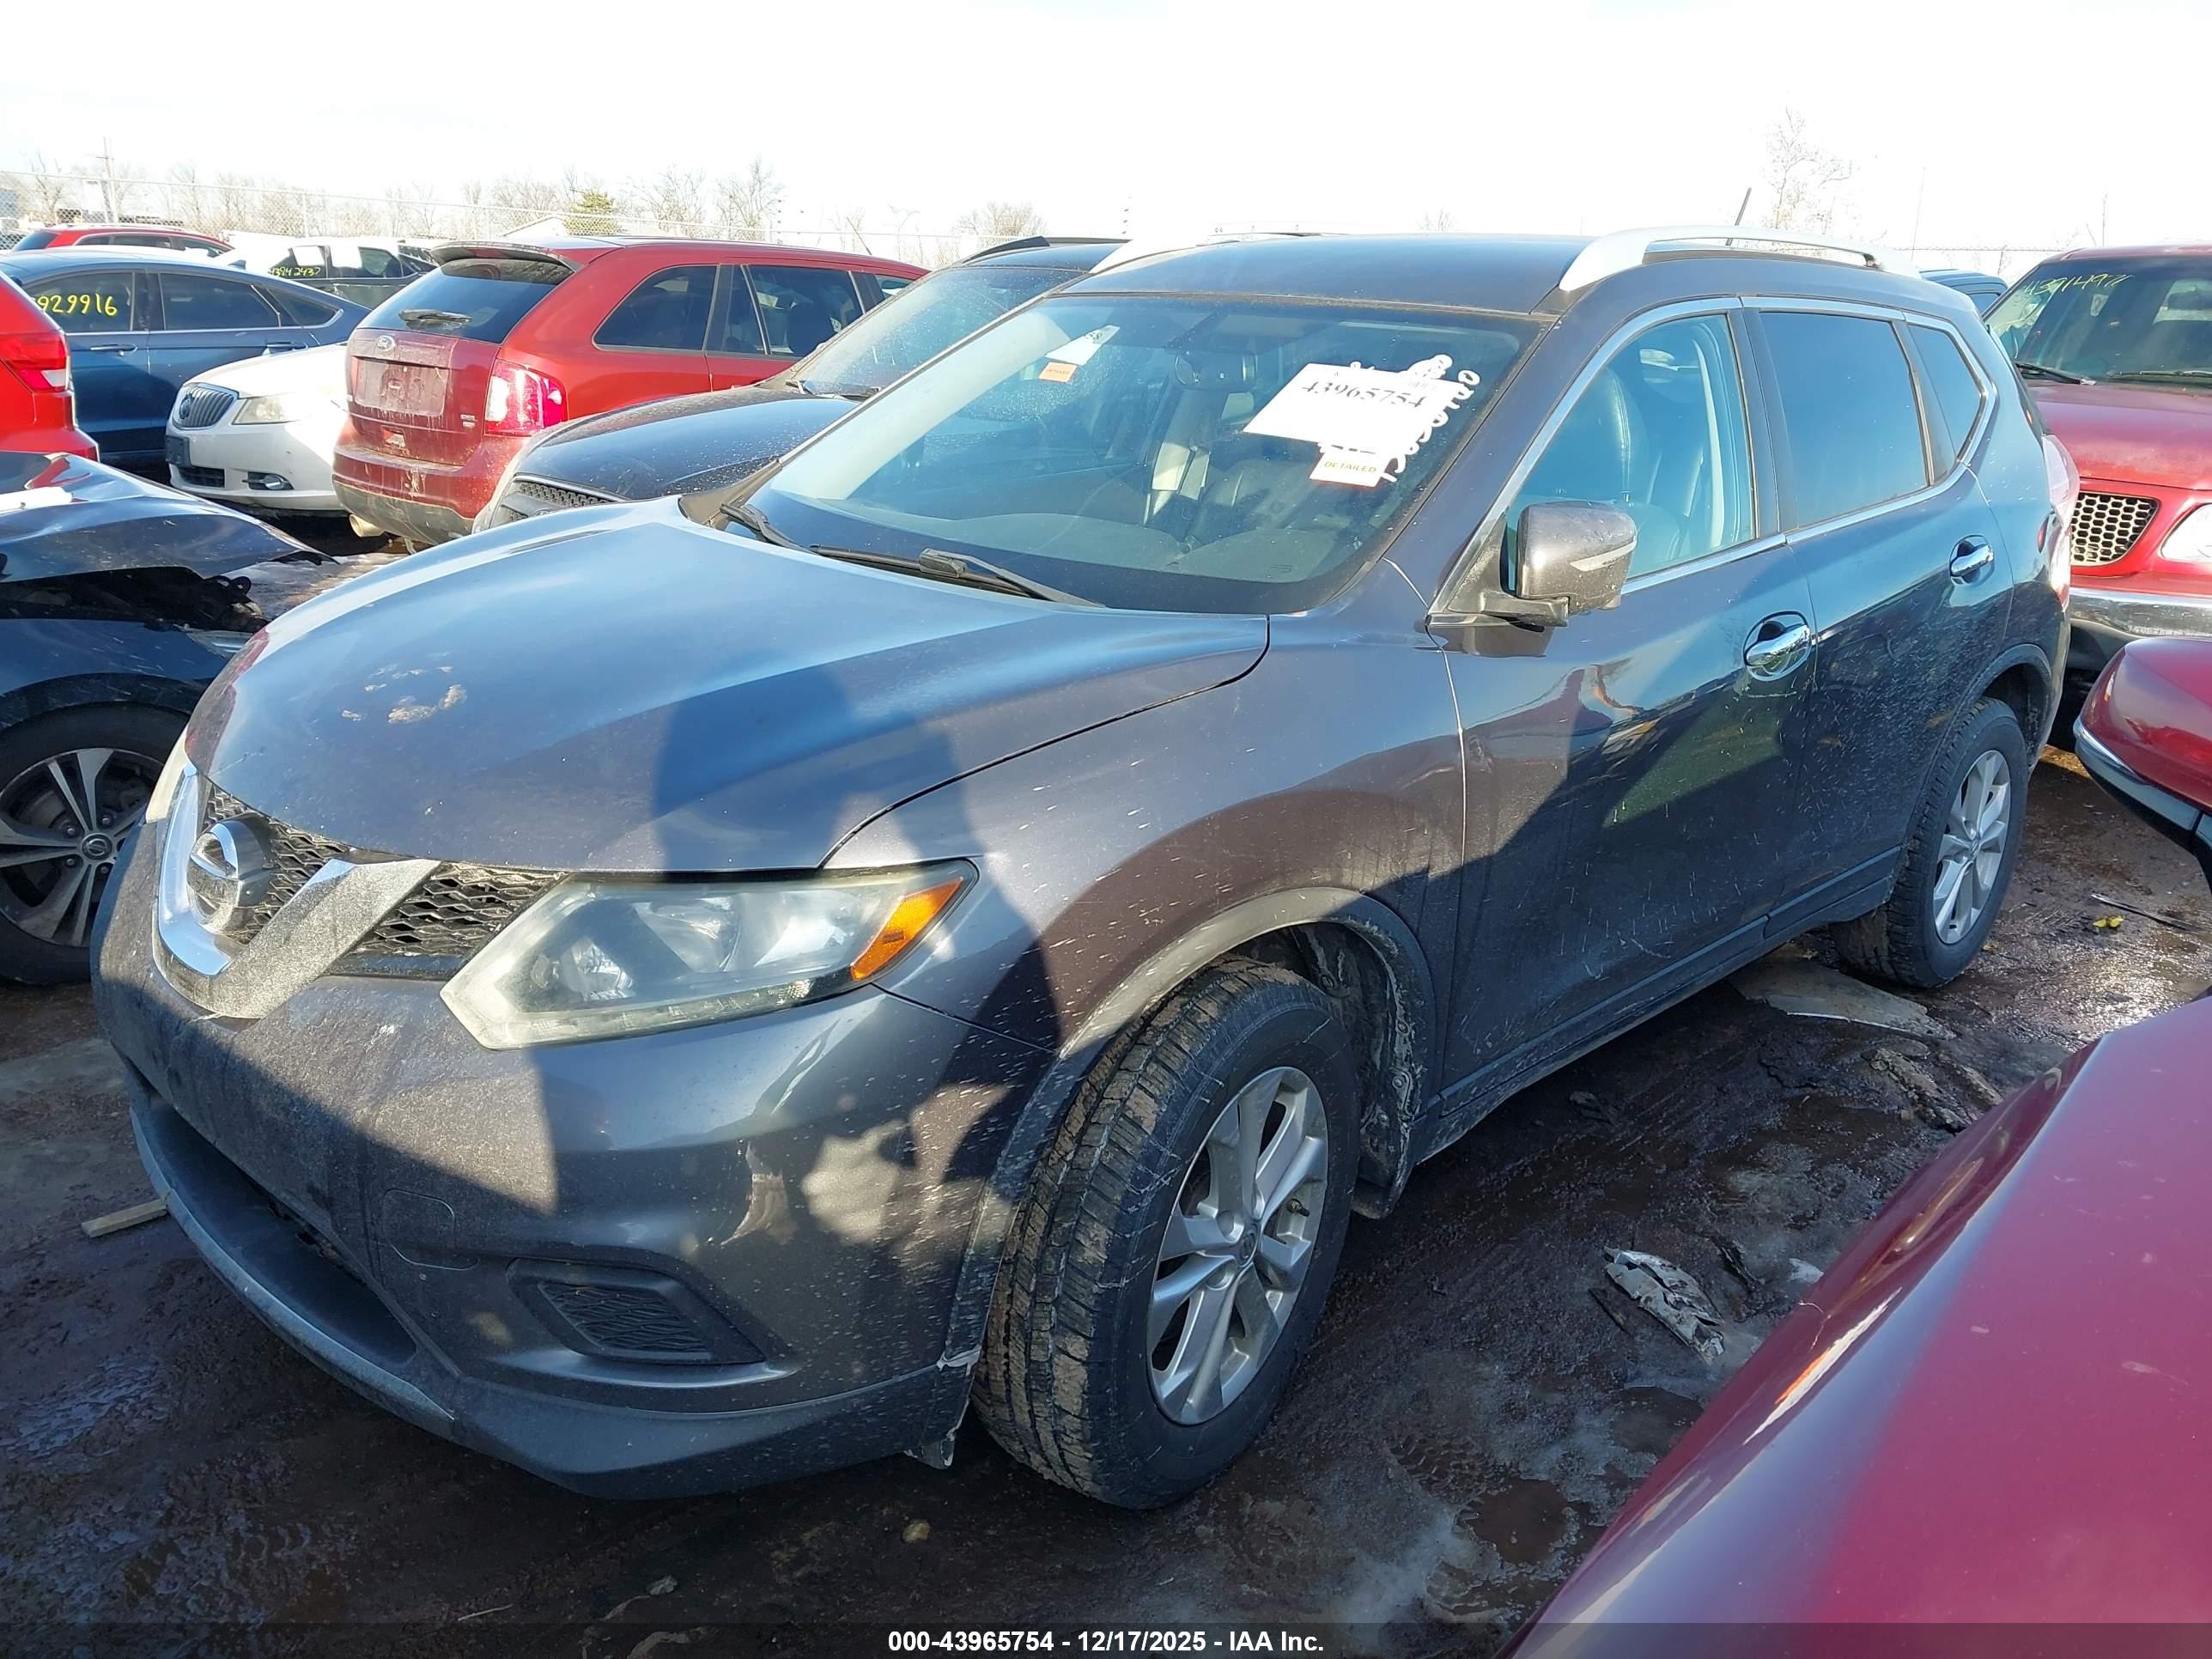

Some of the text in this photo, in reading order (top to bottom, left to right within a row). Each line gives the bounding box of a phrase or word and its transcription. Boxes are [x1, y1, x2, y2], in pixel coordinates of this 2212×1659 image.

[30, 294, 118, 316] 929916
[1301, 380, 1427, 408] 43965754
[1323, 460, 1377, 474] DETAILED
